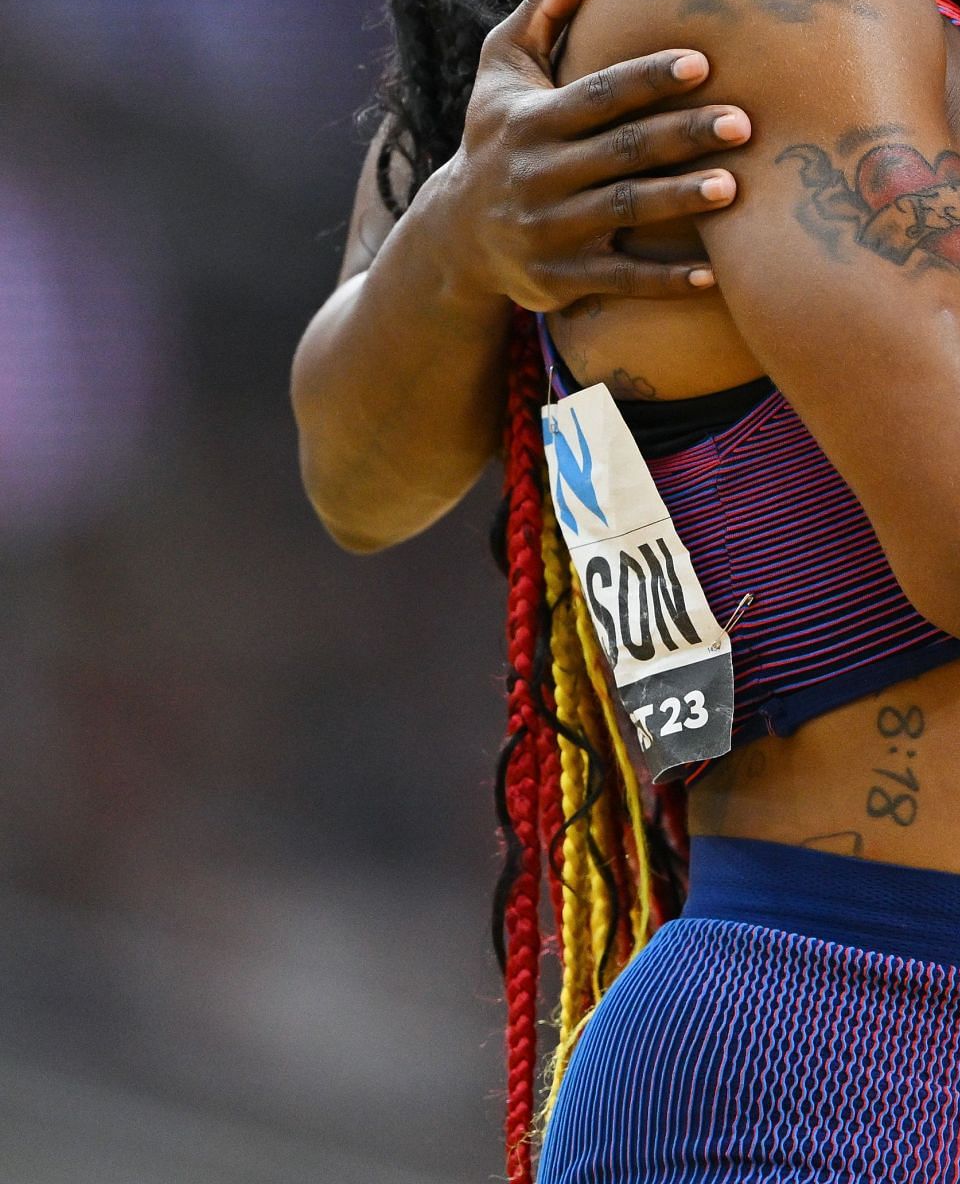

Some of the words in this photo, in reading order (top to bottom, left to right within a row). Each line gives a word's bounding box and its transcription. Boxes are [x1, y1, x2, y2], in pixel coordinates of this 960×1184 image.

[586, 537, 703, 668] SON
[658, 689, 709, 737] 23
[867, 704, 926, 827] 8:18
